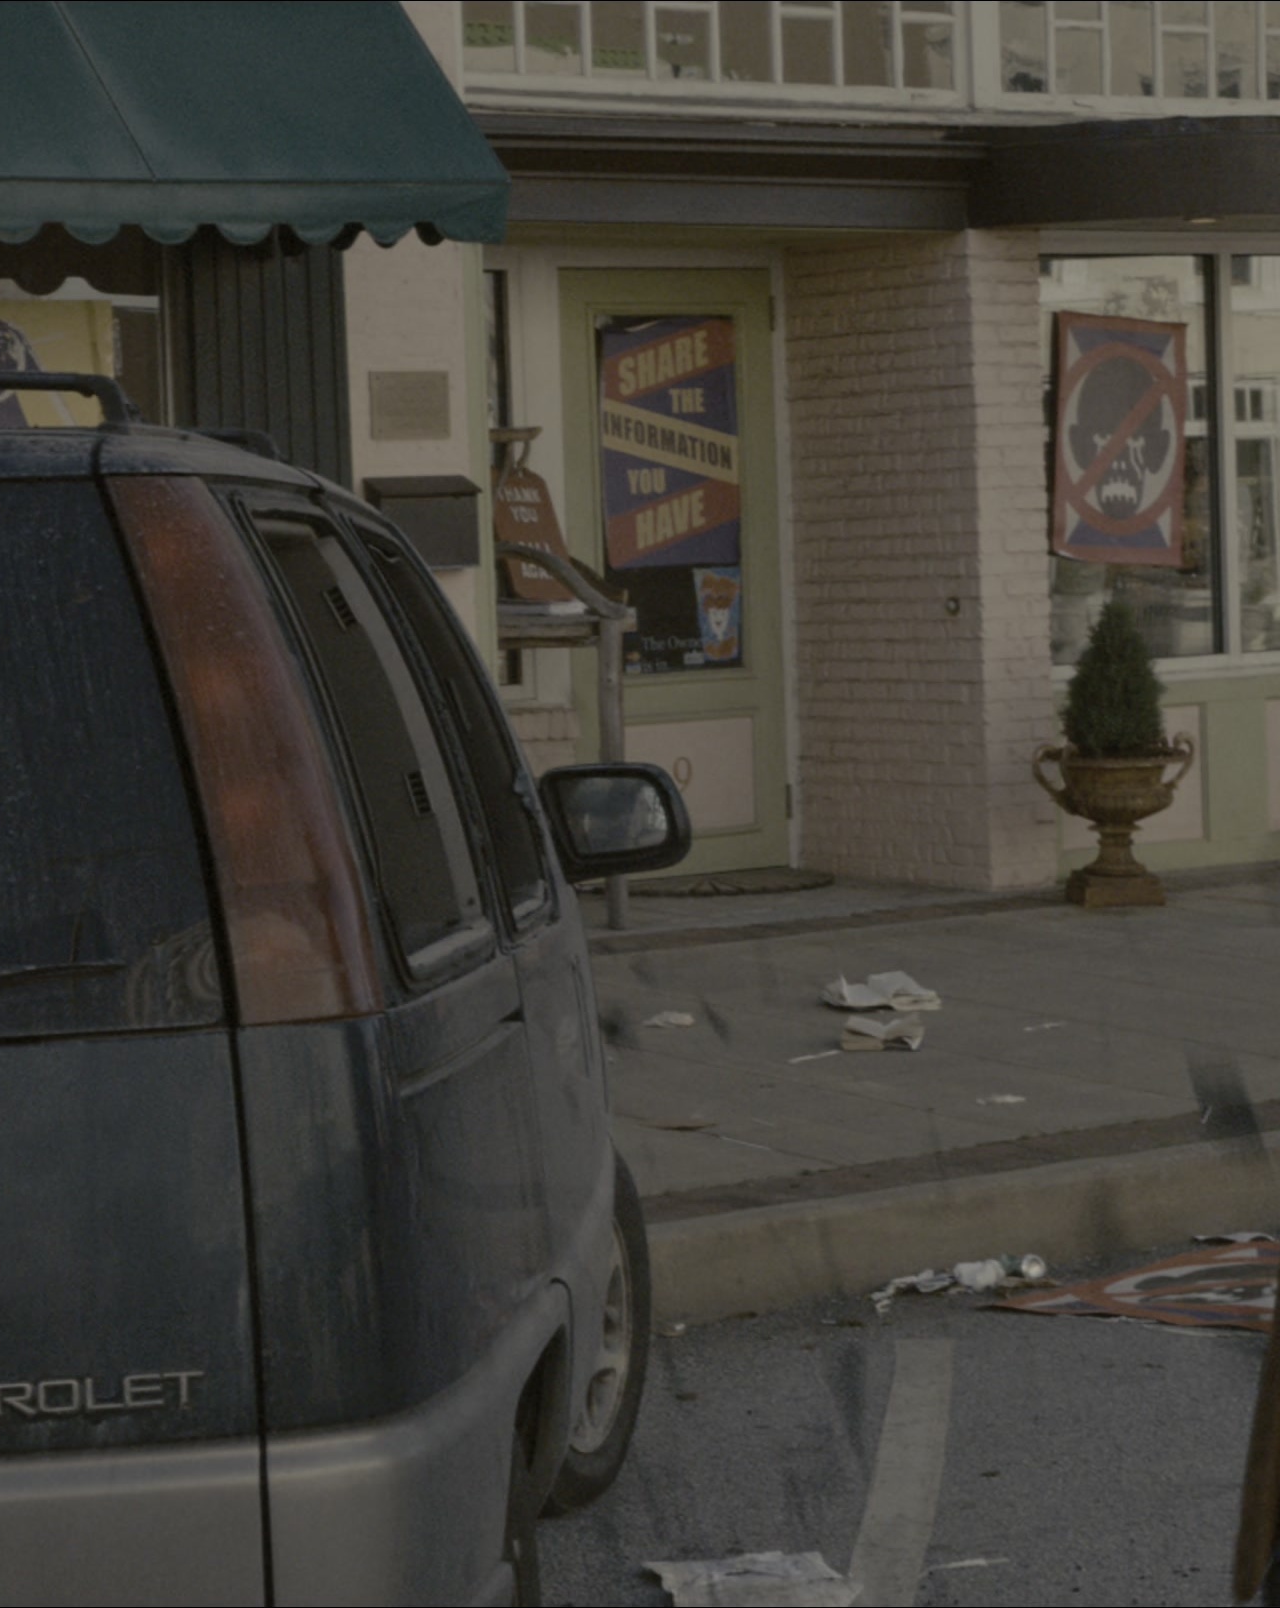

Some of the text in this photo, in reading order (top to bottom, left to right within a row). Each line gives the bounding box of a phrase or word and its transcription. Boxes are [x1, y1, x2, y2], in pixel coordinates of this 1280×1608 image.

[618, 329, 709, 396] SHARE
[668, 387, 706, 415] THE
[603, 410, 733, 471] INFORMATION
[626, 467, 667, 496] YOU
[636, 489, 706, 550] HAVE
[667, 634, 702, 651] Owne
